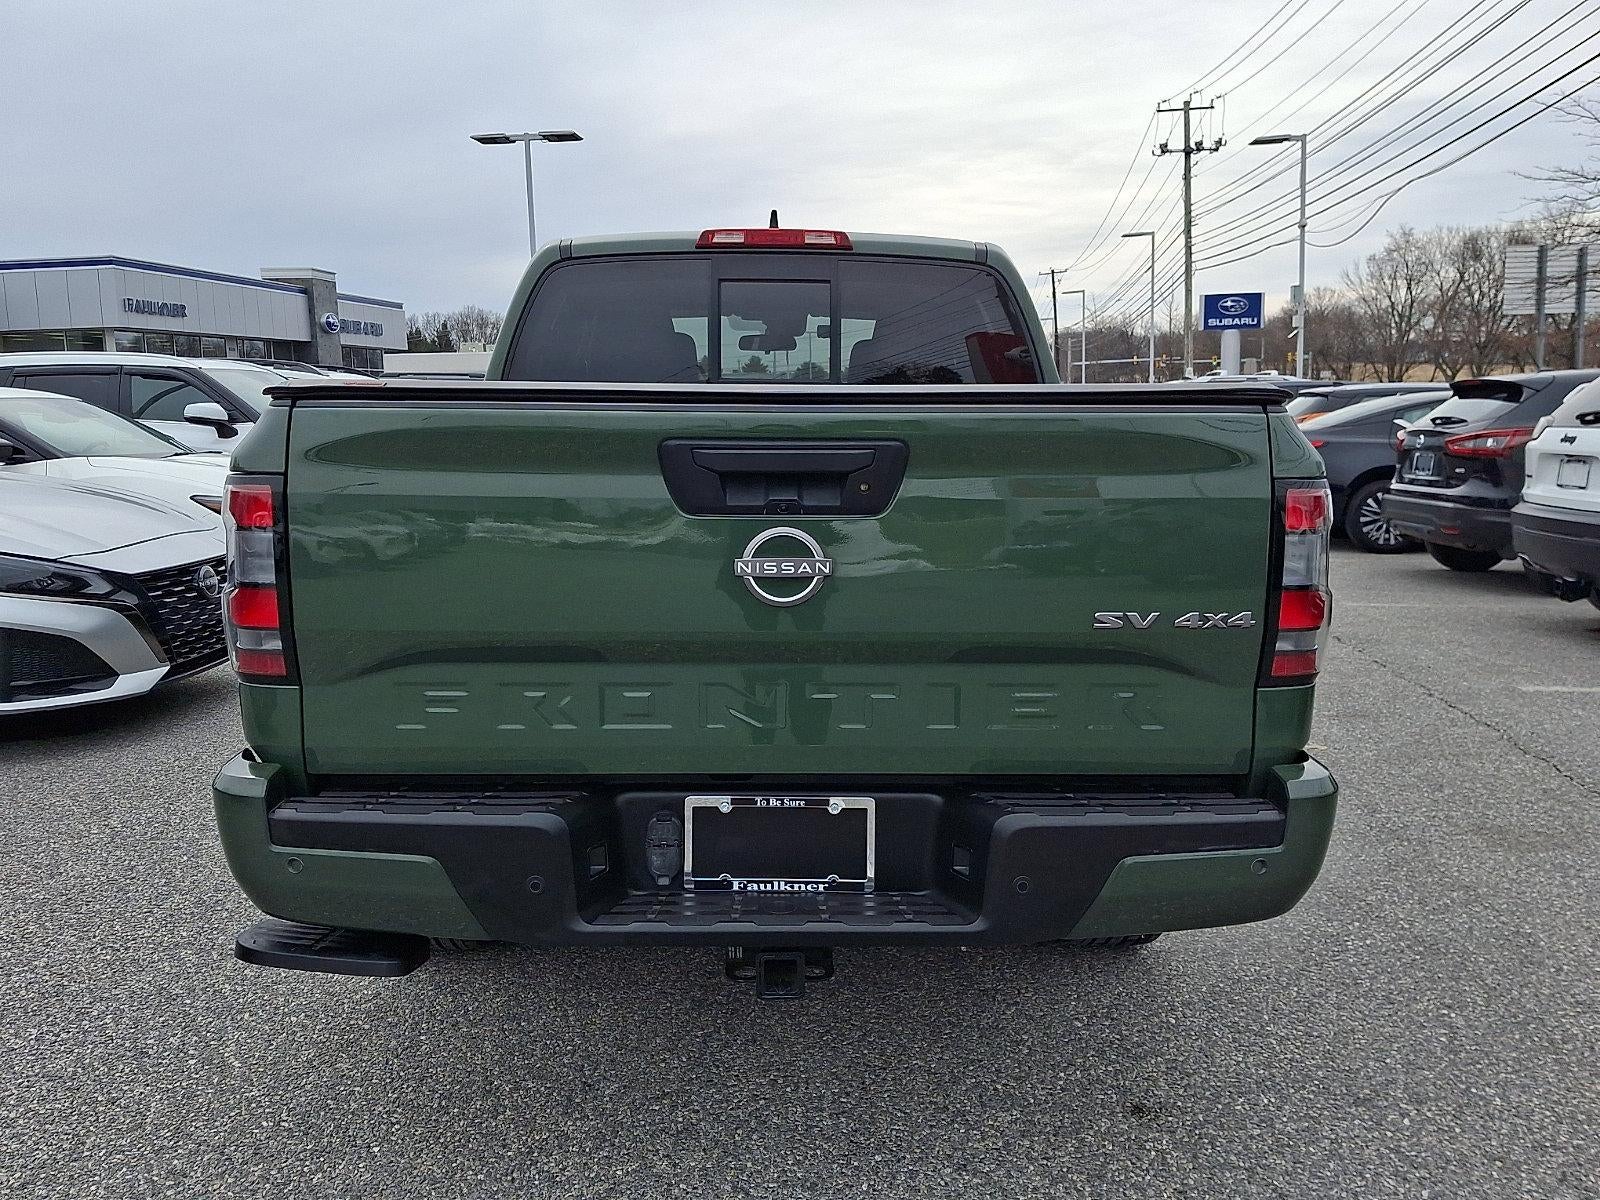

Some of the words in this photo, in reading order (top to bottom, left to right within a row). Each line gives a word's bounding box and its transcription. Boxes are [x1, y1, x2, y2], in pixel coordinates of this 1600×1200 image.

[123, 297, 188, 318] FAULKNER
[339, 318, 384, 337] SUBARU
[1207, 317, 1258, 327] SUBARU
[737, 561, 830, 574] NISSAN
[1093, 611, 1161, 629] SV
[396, 682, 1165, 730] FRONTIER
[754, 797, 767, 807] To
[769, 798, 782, 807] Be
[783, 798, 806, 807] Sure
[731, 880, 829, 892] Faulkner
